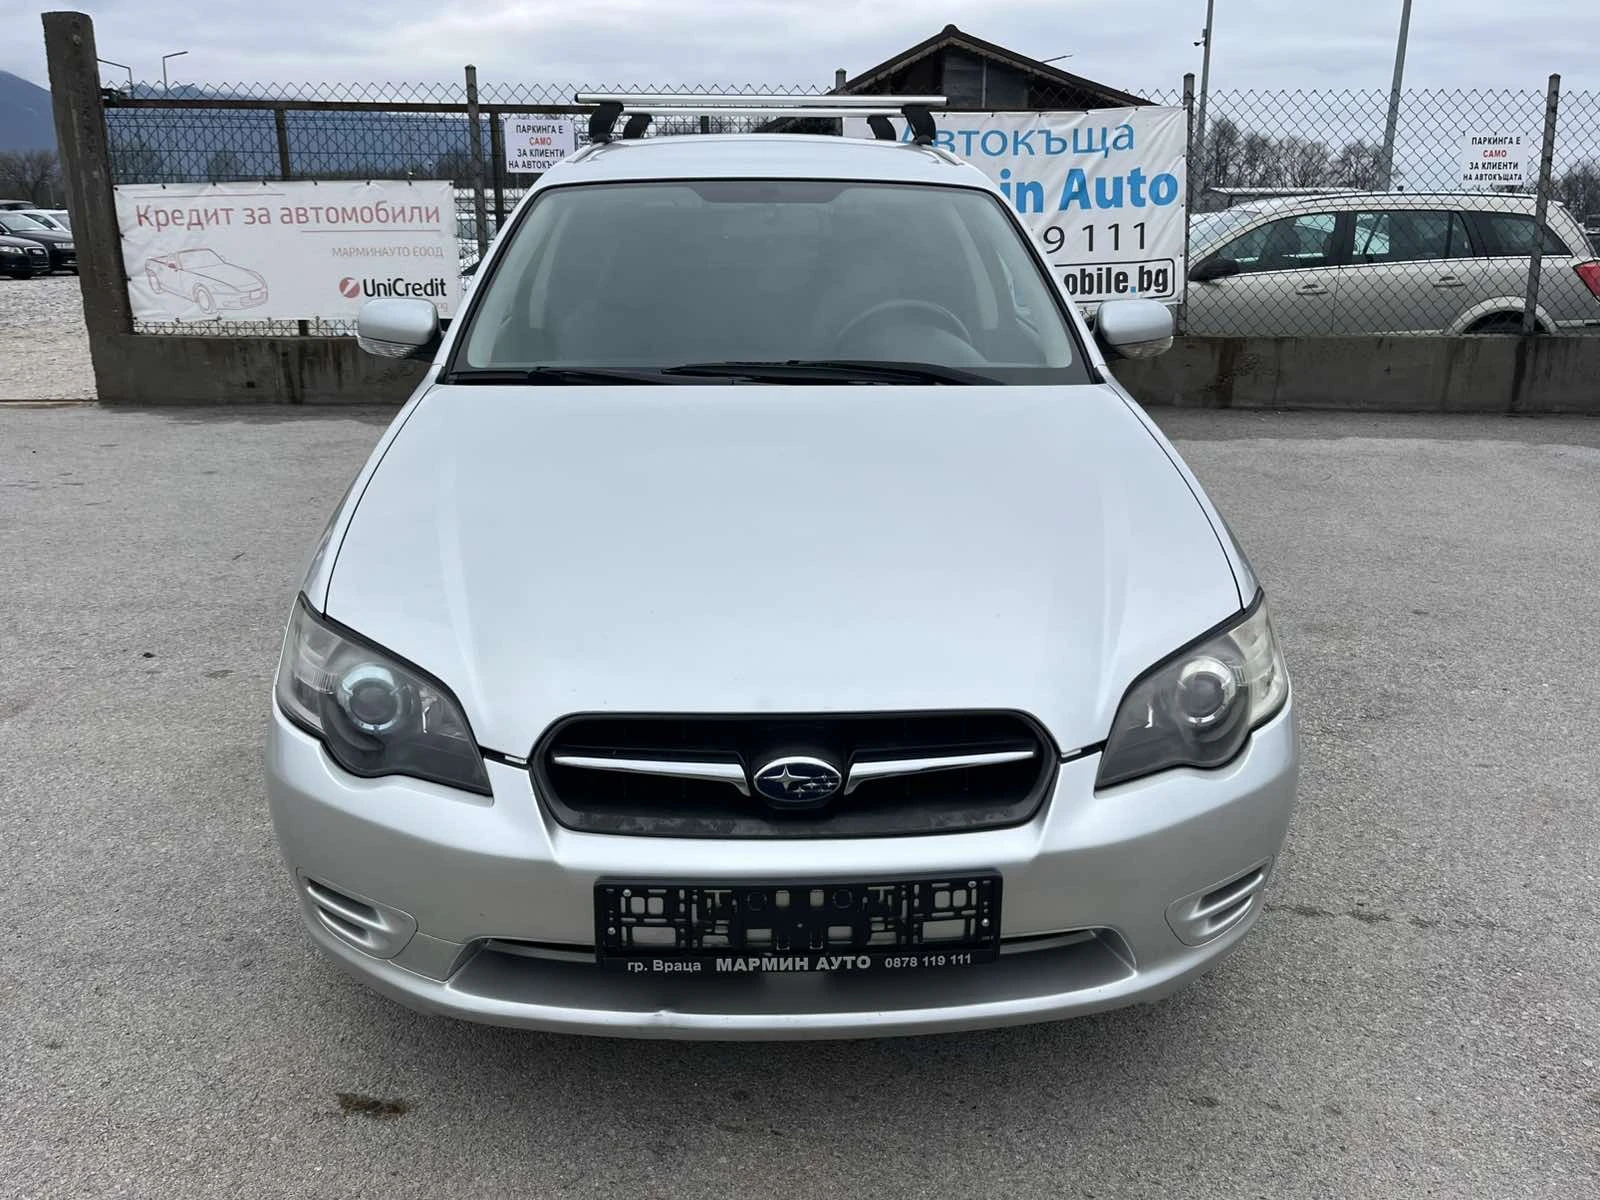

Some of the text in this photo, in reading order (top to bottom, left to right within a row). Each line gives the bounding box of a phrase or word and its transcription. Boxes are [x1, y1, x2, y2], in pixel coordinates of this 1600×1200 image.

[516, 125, 564, 133] ПАРКИНГА Е
[529, 137, 552, 145] САМО
[1471, 137, 1520, 145] ПАРКИНГА Е
[517, 149, 564, 157] ЗА КЛИЕНТИ
[508, 160, 557, 168] НА АВТОКЪ
[1469, 162, 1519, 170] ЗА КЛИЕНТИ
[1474, 173, 1522, 181] АВТОКЪЩАТА
[1000, 166, 1179, 214] in Auto
[135, 200, 440, 232] Кредит за автомобили
[1043, 226, 1065, 254] 9
[332, 246, 444, 257] МАРМИНАУТО ЕООД
[1064, 265, 1168, 295] obile.bg
[363, 278, 447, 297] UniCredit
[627, 953, 972, 972] гр. Враца МАРМИН АУТО 0878 119 111
